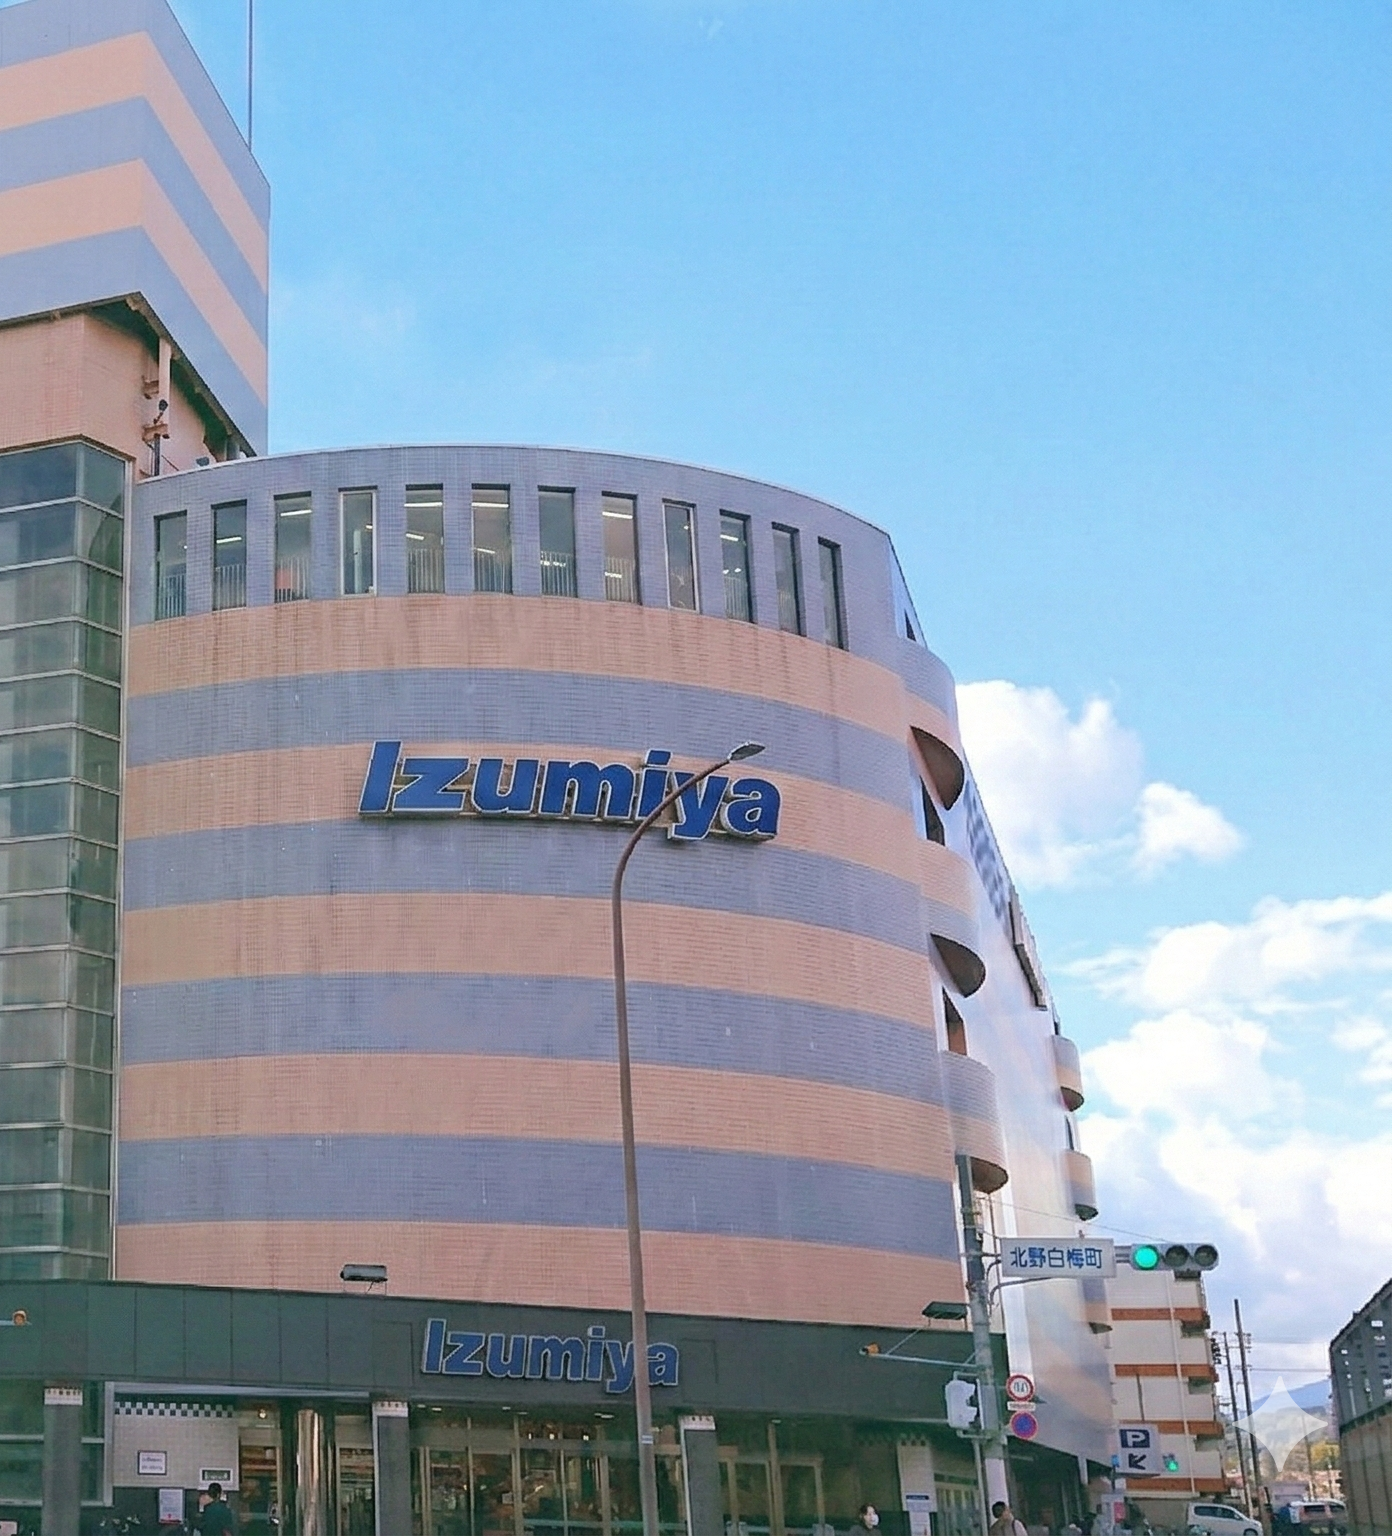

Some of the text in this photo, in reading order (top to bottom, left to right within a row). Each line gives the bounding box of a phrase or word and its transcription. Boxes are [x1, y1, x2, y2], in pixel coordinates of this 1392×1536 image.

[358, 740, 782, 841] Izumiya
[1010, 1246, 1103, 1269] 北野白梅町
[421, 1317, 680, 1394] Izumiya
[1126, 1430, 1147, 1447] P
